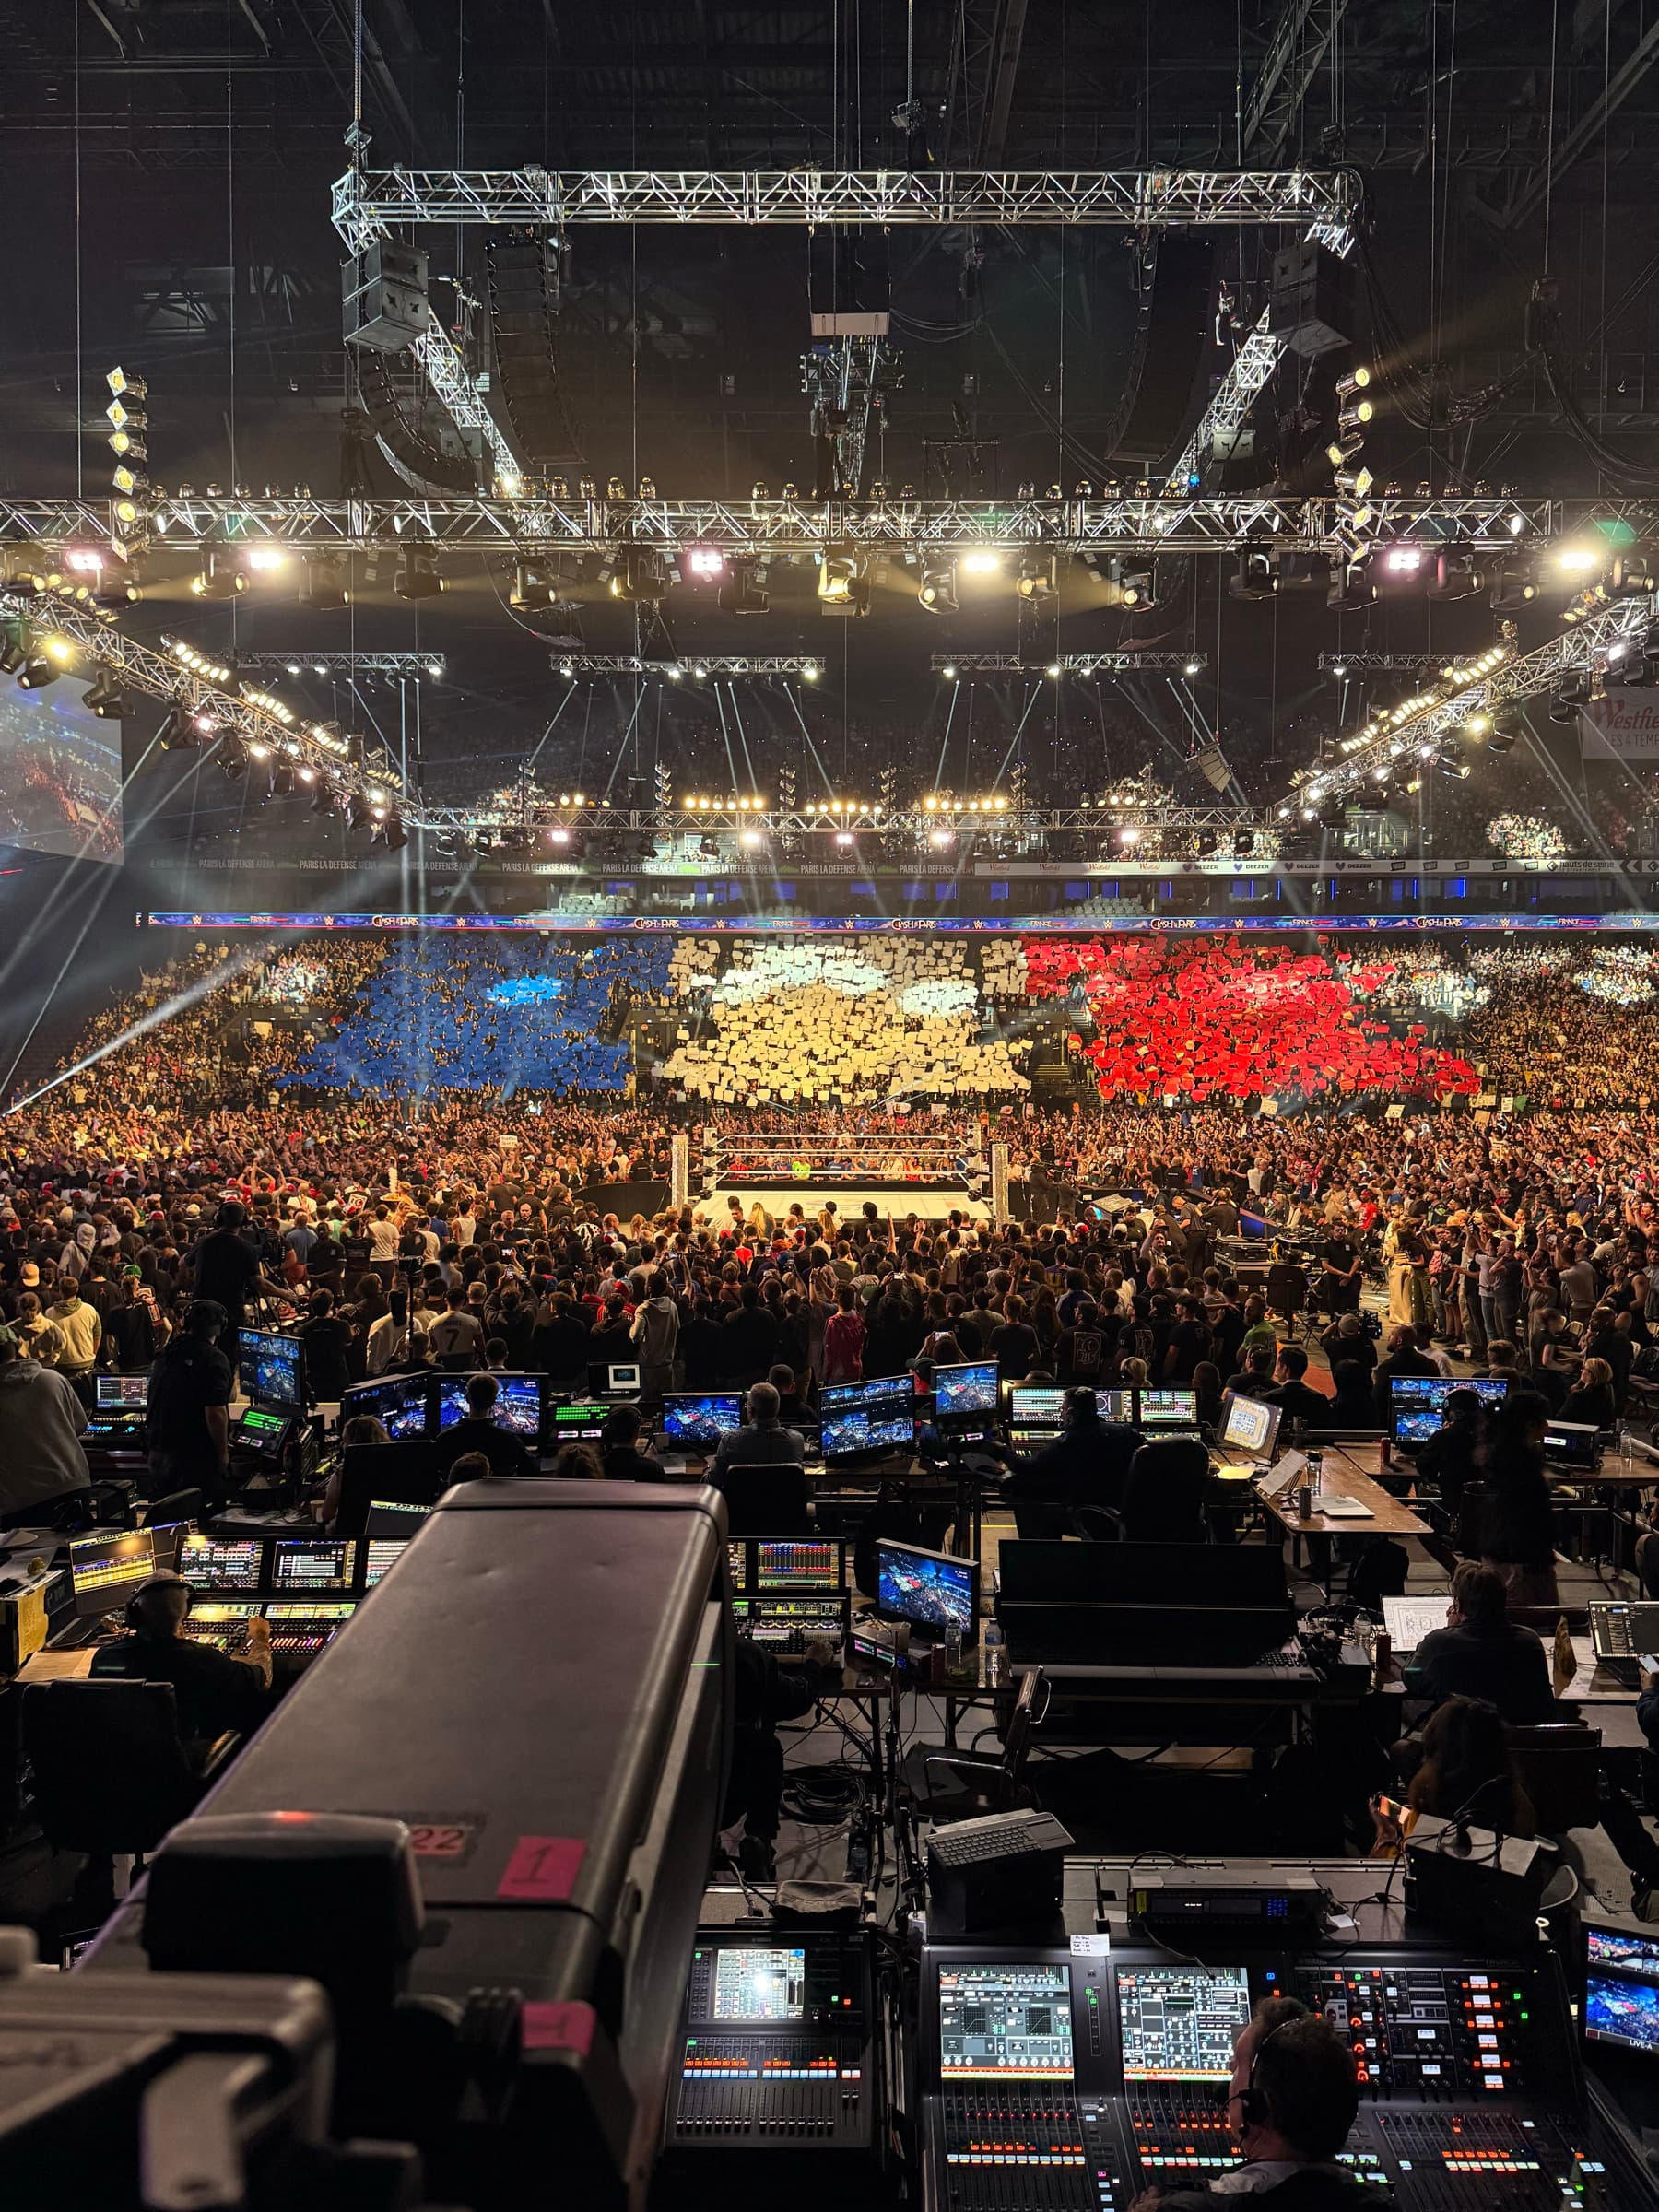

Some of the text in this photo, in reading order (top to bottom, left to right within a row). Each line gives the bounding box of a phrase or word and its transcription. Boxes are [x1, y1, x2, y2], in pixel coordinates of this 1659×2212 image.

[300, 860, 319, 870] PARIS
[320, 860, 328, 870] LA
[329, 860, 357, 870] DEFENSE
[430, 862, 458, 871] DEFENSE
[502, 863, 579, 872] PARIS LA DEFENSE ARENA
[603, 864, 621, 873] PARIS
[622, 864, 630, 873] LA
[631, 864, 658, 873] DEFENSE
[701, 864, 721, 874] PARIS
[722, 864, 729, 874] LA
[730, 864, 758, 874] DEFENSE
[801, 865, 819, 874] PARIS
[820, 865, 829, 874] LA
[830, 865, 856, 874] DEFENSE
[900, 865, 918, 875] PARIS
[919, 865, 927, 875] LA
[928, 865, 955, 875] DEFENSE
[446, 1328, 460, 1352] 7
[1630, 2038, 1653, 2052] LIVE-A
